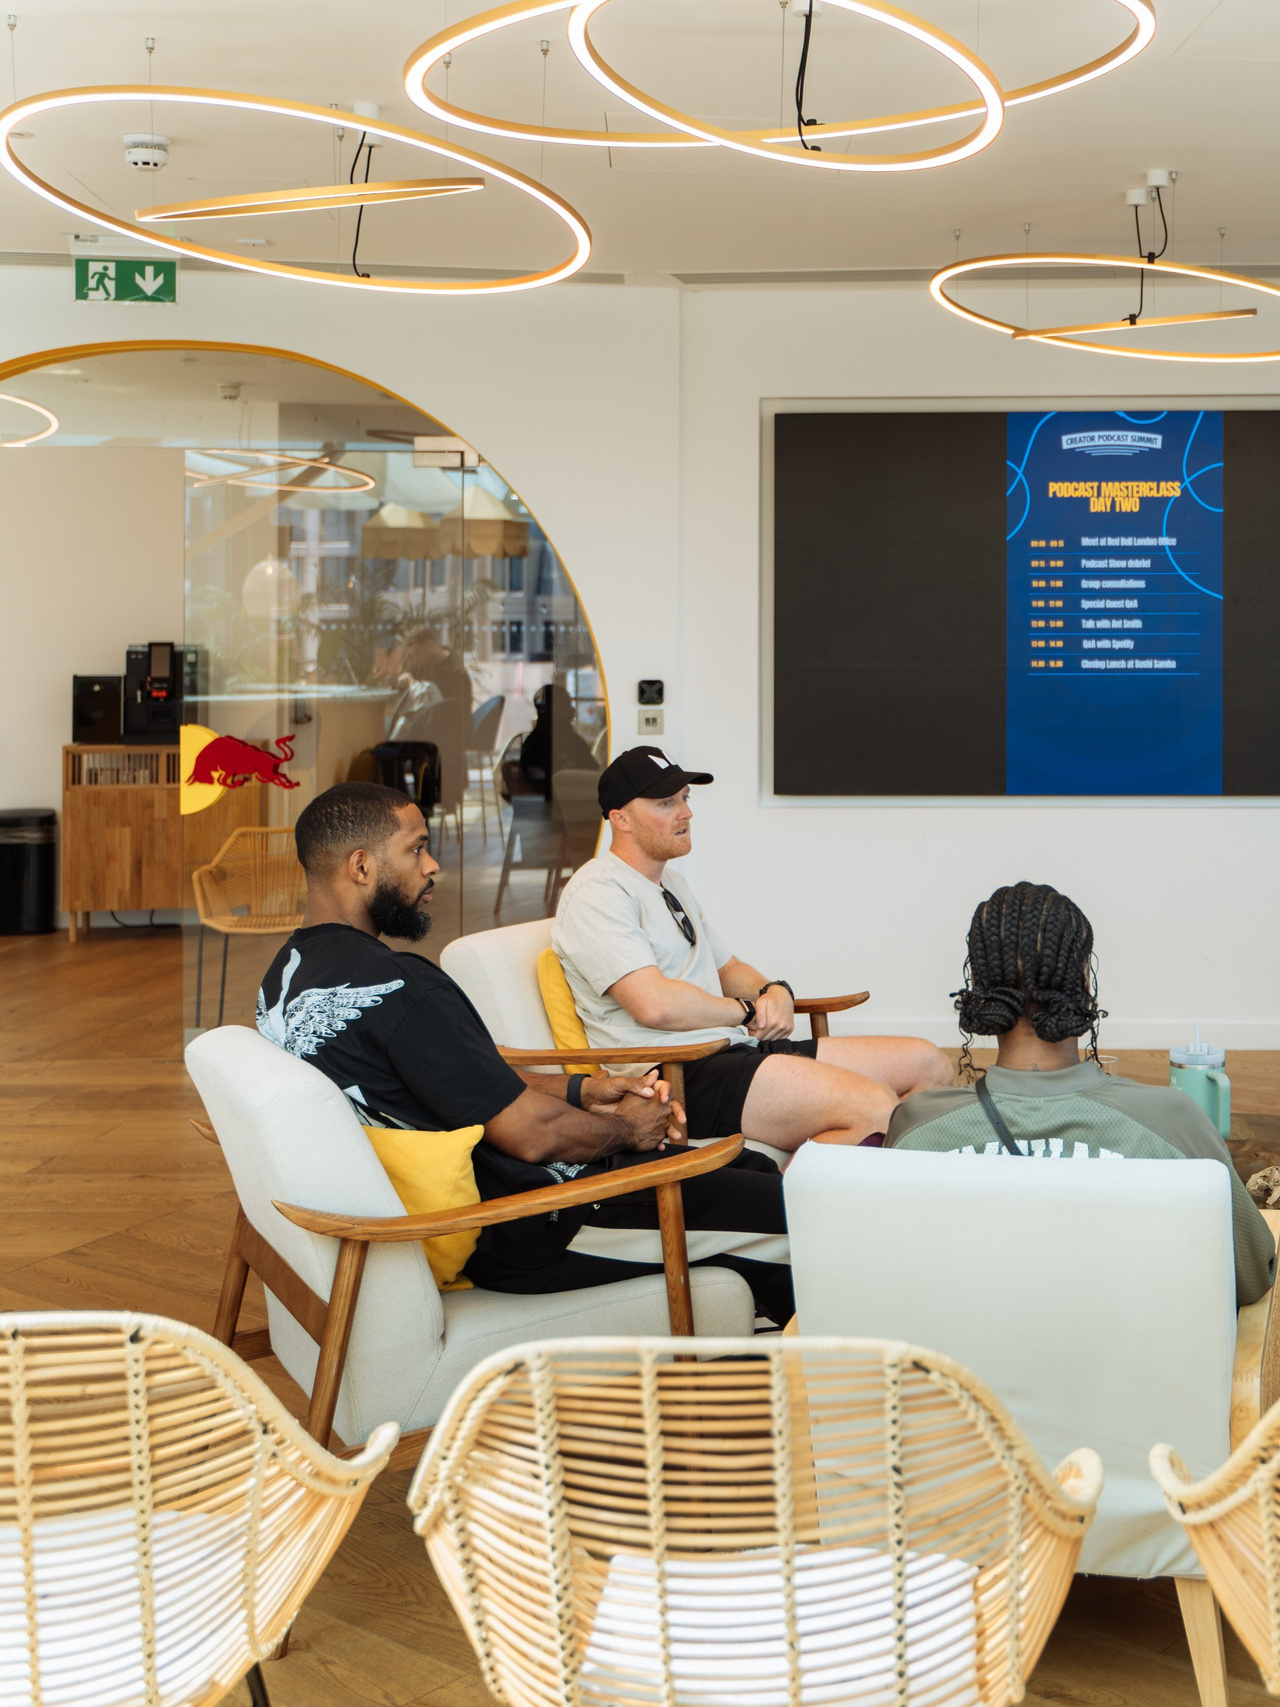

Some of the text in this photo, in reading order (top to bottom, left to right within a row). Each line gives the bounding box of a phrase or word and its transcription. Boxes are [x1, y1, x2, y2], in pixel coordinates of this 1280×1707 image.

[1066, 434, 1158, 446] CREATOR PODCAST SUMMIT
[1048, 481, 1181, 498] PODCAST MASTERCLASS
[1089, 497, 1140, 513] DAY TWO
[1081, 537, 1177, 547] Meet at Red Bull London Office
[1081, 559, 1151, 569] Podcast Show debrief
[1081, 579, 1146, 590] Group consultations
[1081, 599, 1138, 610] Special Guest Q&A
[1081, 619, 1142, 629] Talk with Ant Smith
[1082, 639, 1134, 650] Q&A with Spotify
[1081, 660, 1176, 670] Closing Lunch at Sushi Samba
